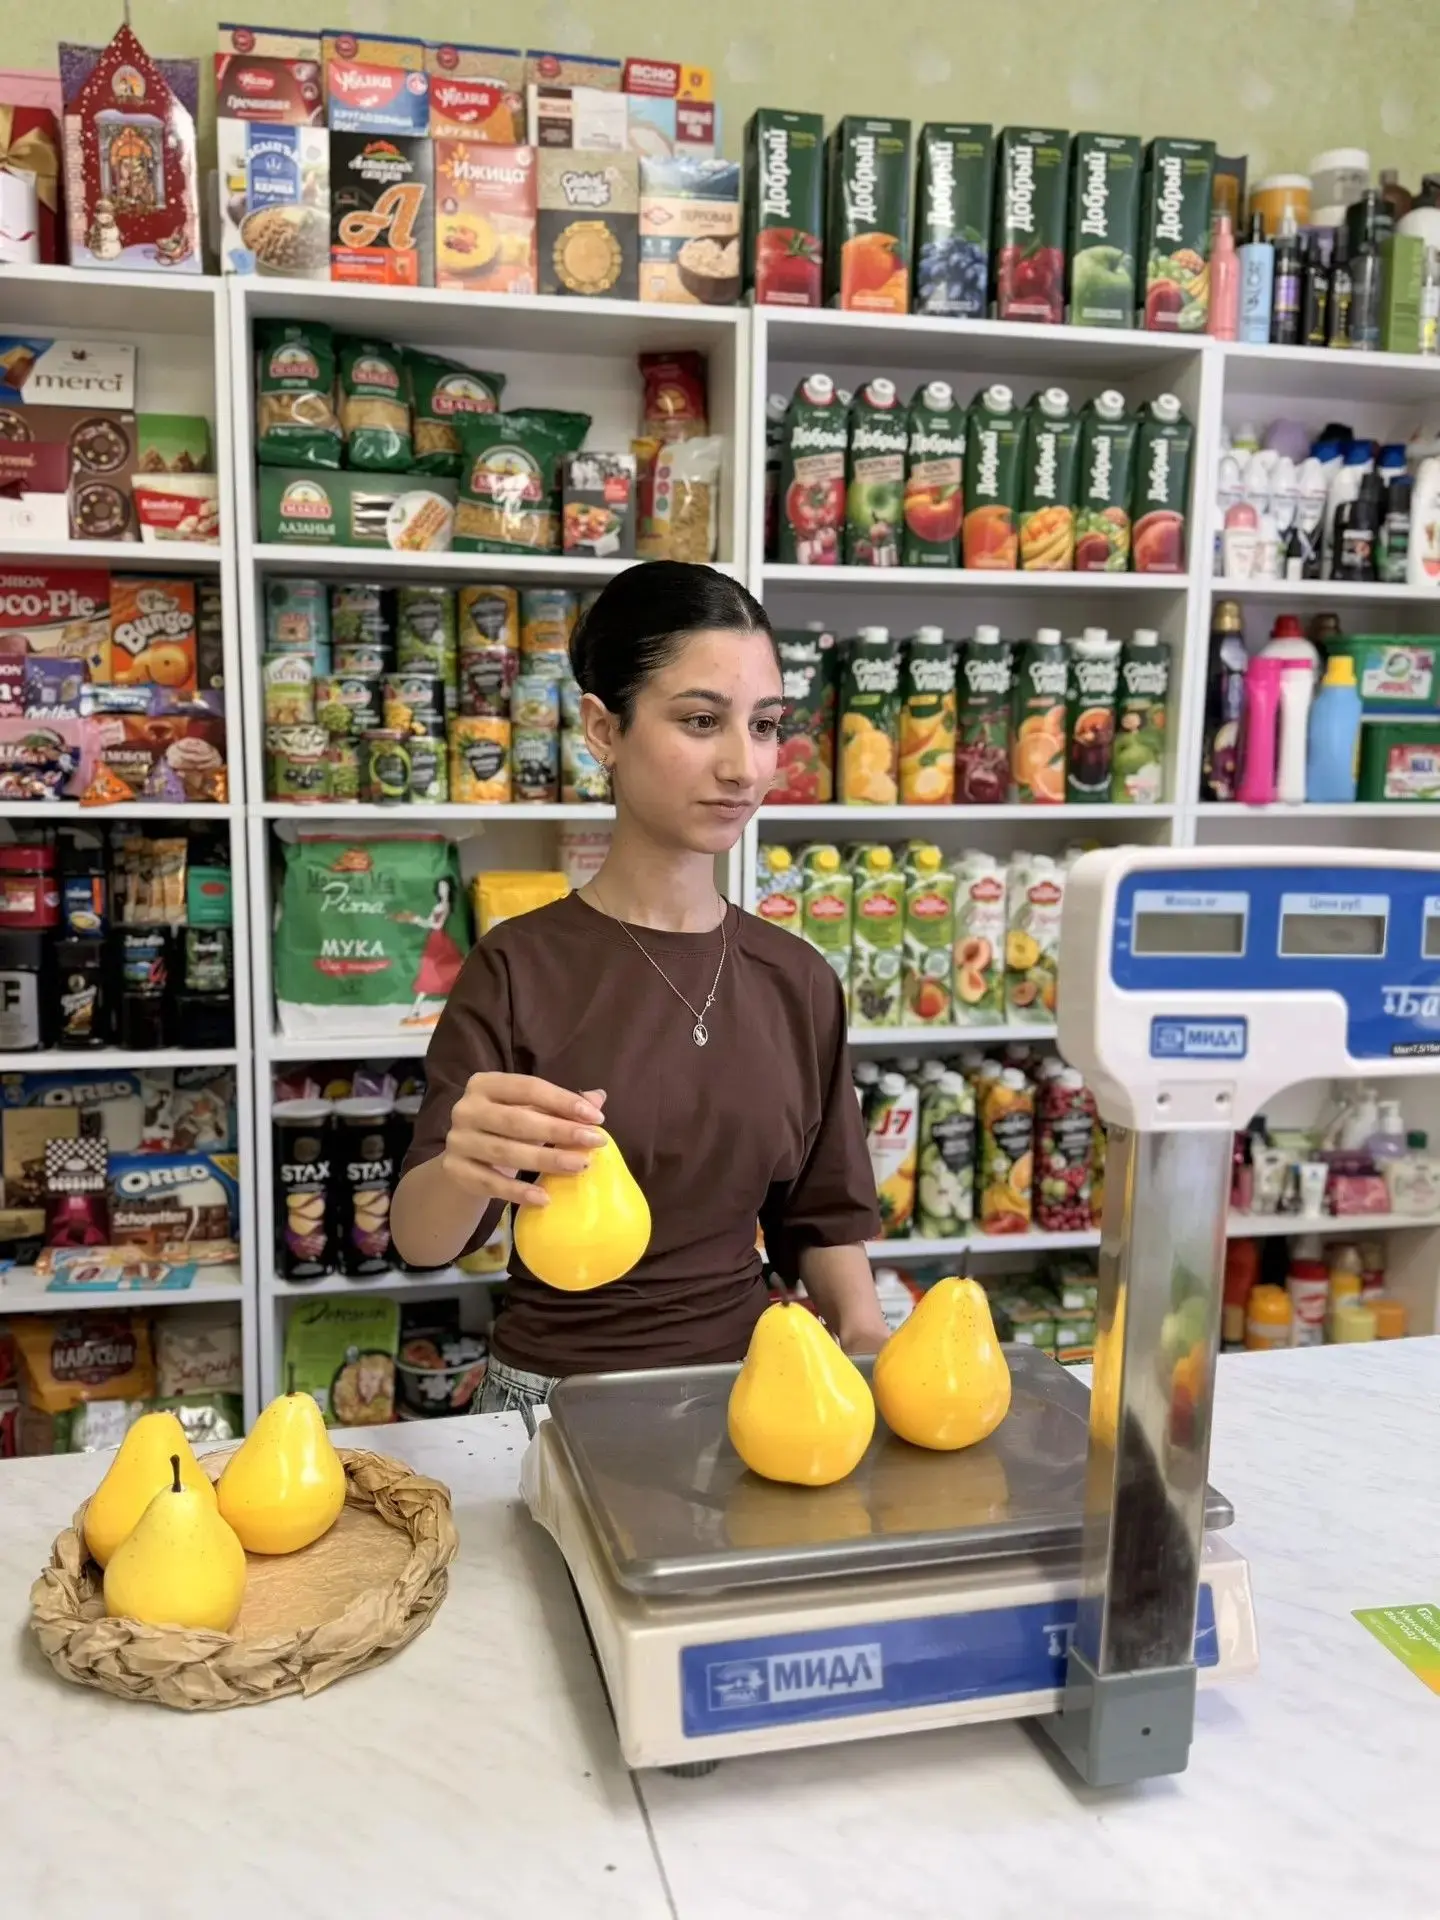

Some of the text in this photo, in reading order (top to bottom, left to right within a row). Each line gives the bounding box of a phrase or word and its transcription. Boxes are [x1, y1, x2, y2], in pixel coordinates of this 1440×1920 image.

[760, 128, 792, 218] Добрый
[846, 135, 878, 224] Добрый
[926, 141, 957, 228] Добрый
[1005, 144, 1036, 233] Добрый
[1081, 150, 1110, 238] Добрый
[1155, 156, 1184, 242] Добрый
[35, 373, 124, 393] merci
[790, 426, 848, 450] Добрый
[851, 427, 908, 451] Добрый
[910, 432, 966, 455] Добрый
[976, 430, 1000, 497] Добрый
[1033, 433, 1057, 499] Добрый
[1089, 436, 1113, 501] Добрый
[1146, 438, 1171, 503] Добрый
[114, 611, 194, 655] Bungo
[1309, 897, 1337, 910] Цена
[124, 935, 164, 947] Jardin
[320, 938, 385, 957] МУКА
[1188, 1030, 1238, 1047] МИДЛ
[44, 1080, 132, 1108] OREO
[119, 1164, 210, 1194] OREO
[280, 1161, 330, 1182] STAX
[347, 1158, 393, 1181] STAX
[112, 1209, 187, 1227] Schogetten
[774, 1652, 873, 1692] МИДЛ
